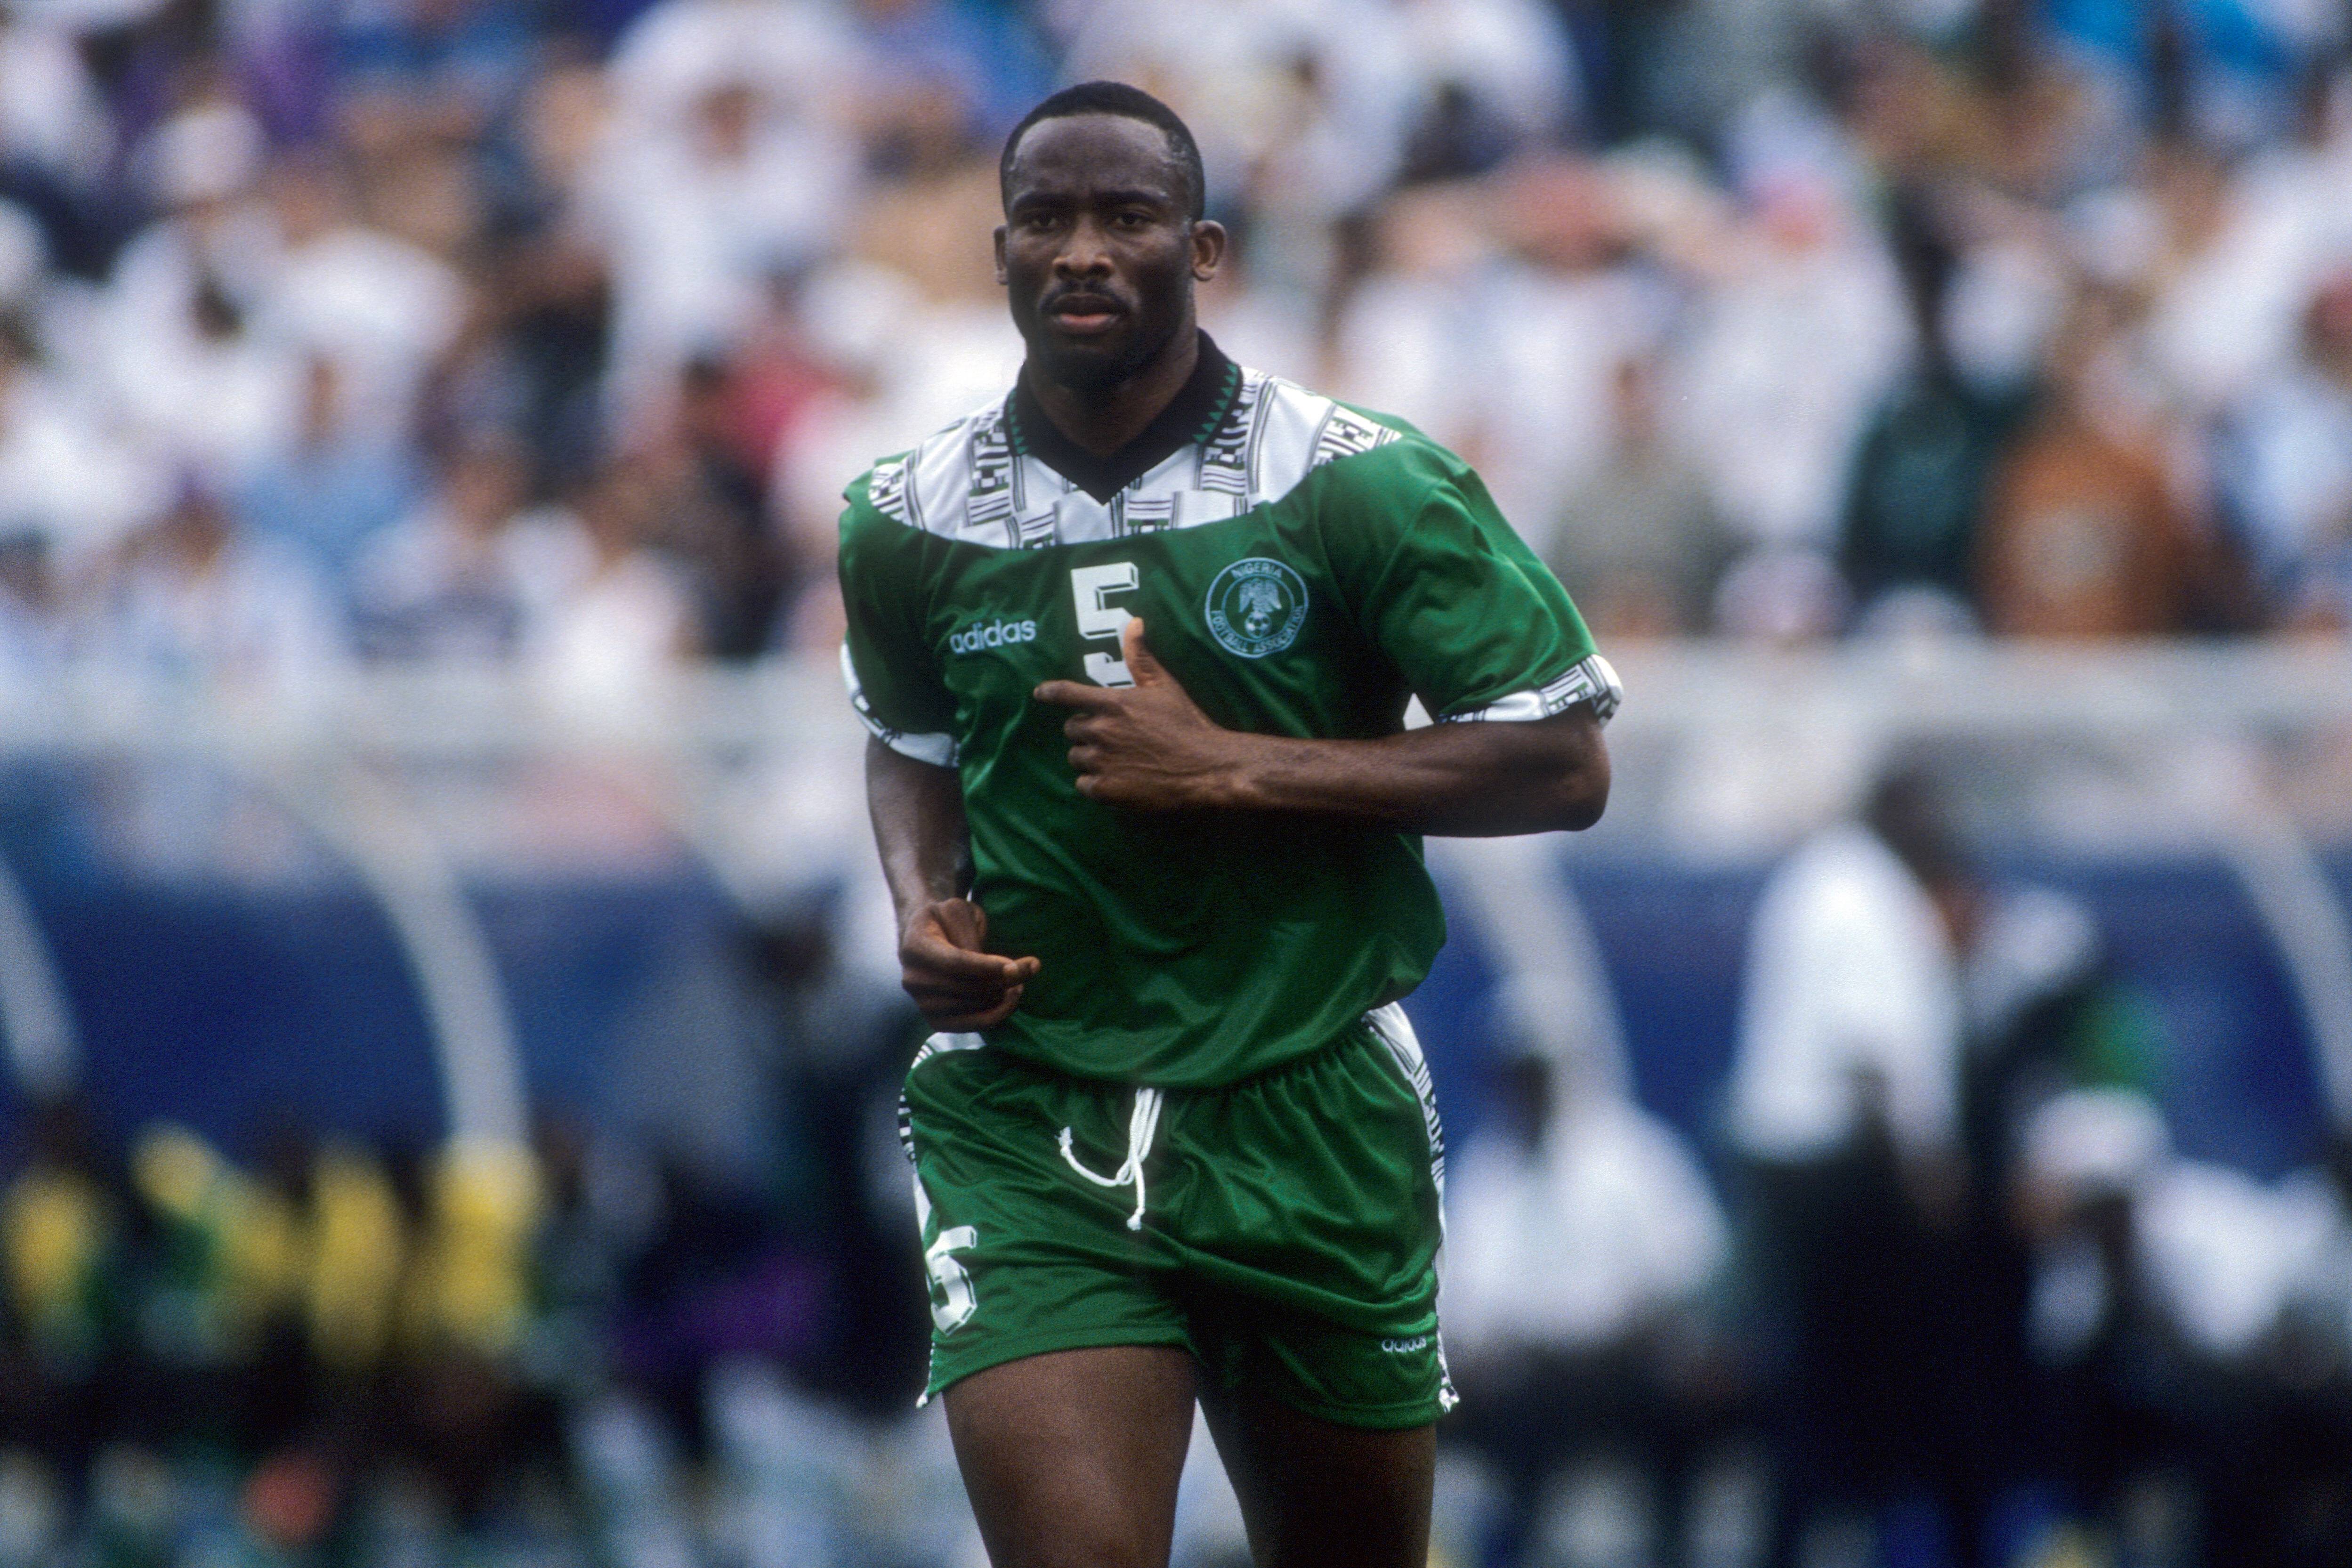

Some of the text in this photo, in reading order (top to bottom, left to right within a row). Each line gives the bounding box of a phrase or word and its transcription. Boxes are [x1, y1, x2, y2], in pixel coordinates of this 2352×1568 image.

[950, 618, 1036, 655] adidas
[1070, 561, 1140, 688] 5
[925, 1225, 978, 1336] 5
